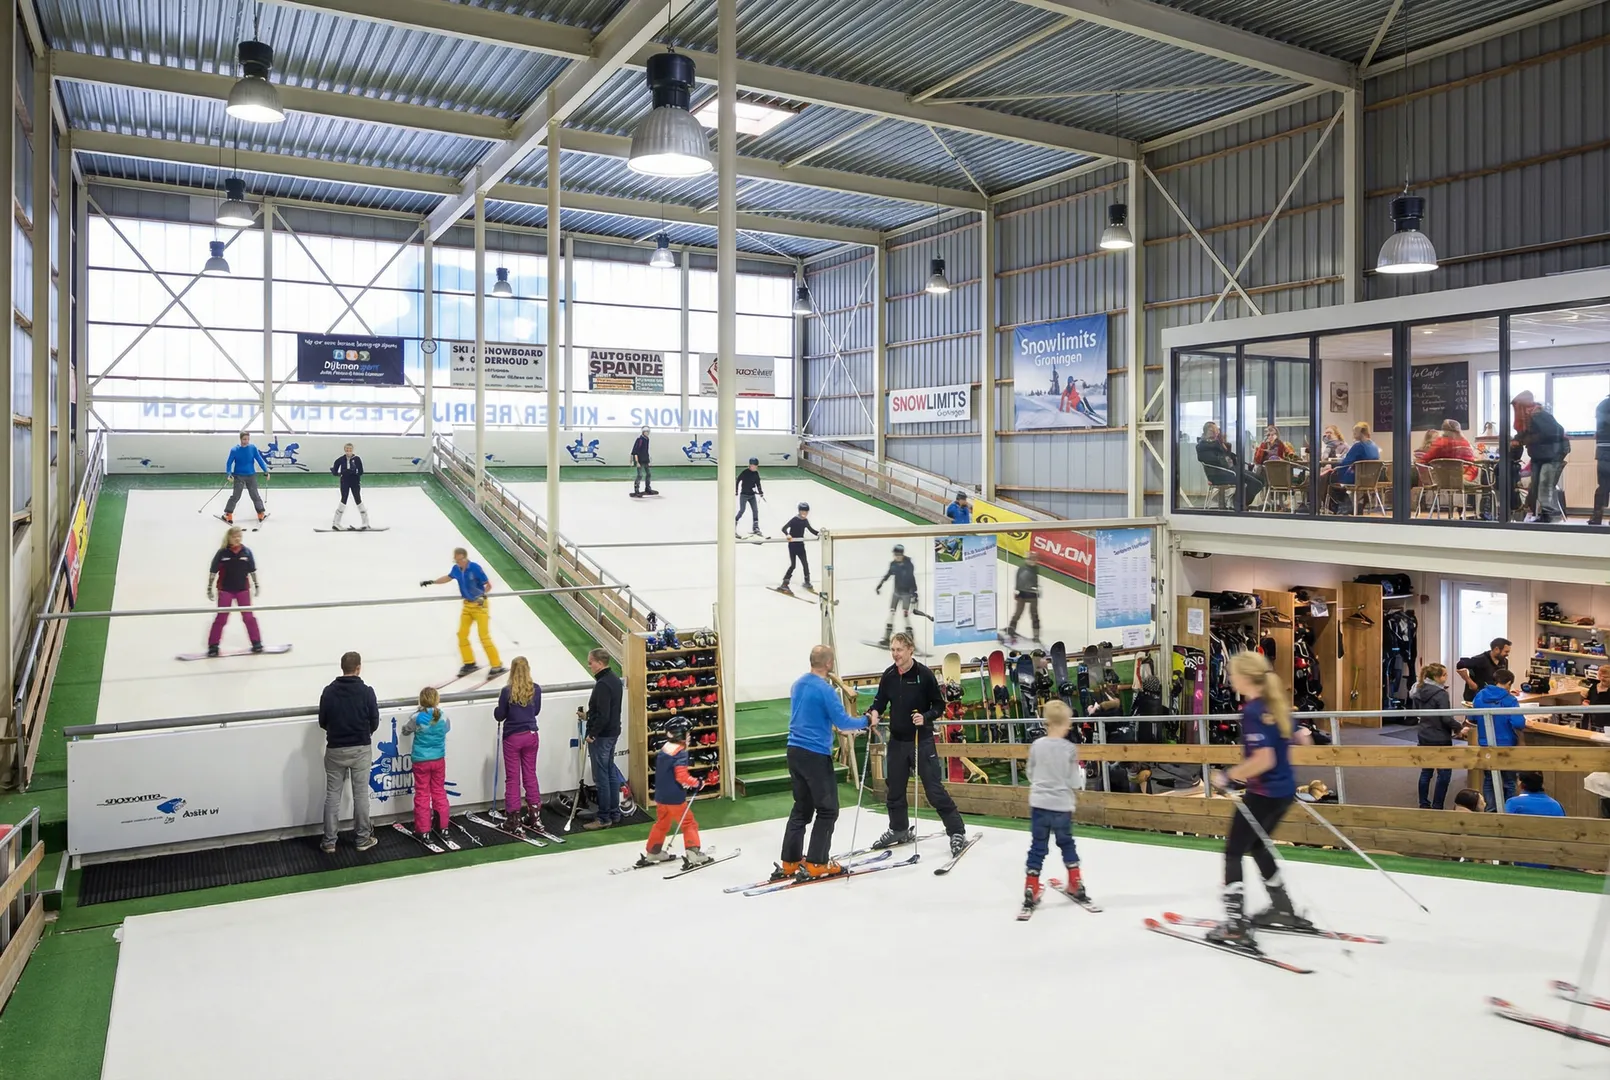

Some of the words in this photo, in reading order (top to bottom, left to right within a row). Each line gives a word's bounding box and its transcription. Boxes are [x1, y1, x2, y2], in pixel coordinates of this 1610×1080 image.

[453, 345, 468, 354] SKI
[1021, 329, 1097, 355] Snowlimits
[1034, 352, 1082, 367] Groningen
[892, 390, 966, 412] SNOWLIMITS
